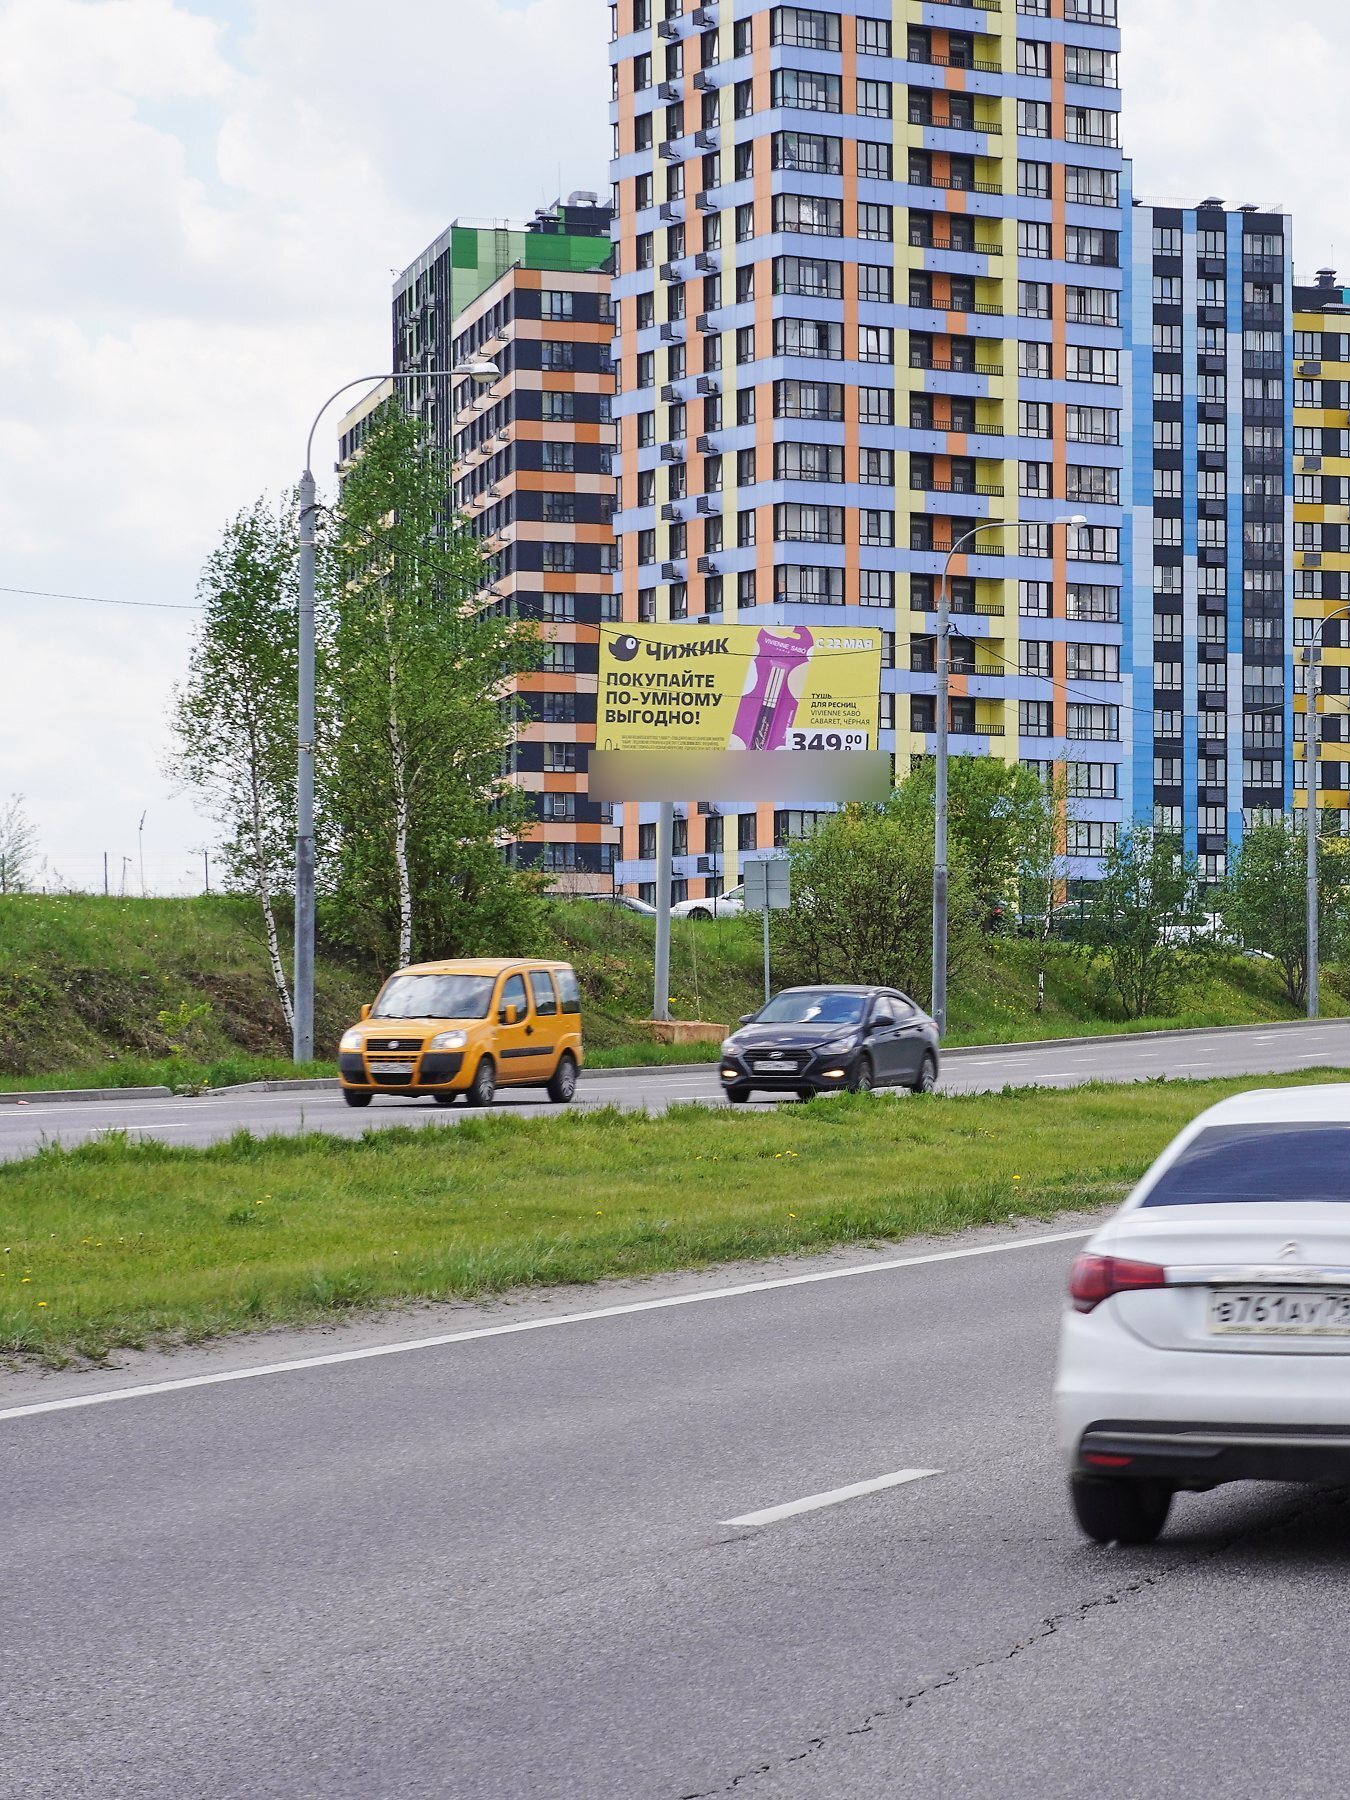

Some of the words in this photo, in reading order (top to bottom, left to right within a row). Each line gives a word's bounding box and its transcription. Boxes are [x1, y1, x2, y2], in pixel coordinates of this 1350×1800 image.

[816, 638, 825, 649] С
[826, 638, 841, 649] 22
[843, 638, 874, 650] МАЯ
[606, 669, 715, 688] ПОКУПАЙТЕ
[605, 691, 723, 707] ПО-УМНОМУ
[811, 701, 827, 709] ДЛЯ
[828, 702, 857, 710] РЕСНИЦ
[605, 709, 701, 727] ВЫГОДНО!
[811, 709, 841, 717] VIVIENNE
[792, 732, 843, 750] 349
[845, 734, 862, 744] 00
